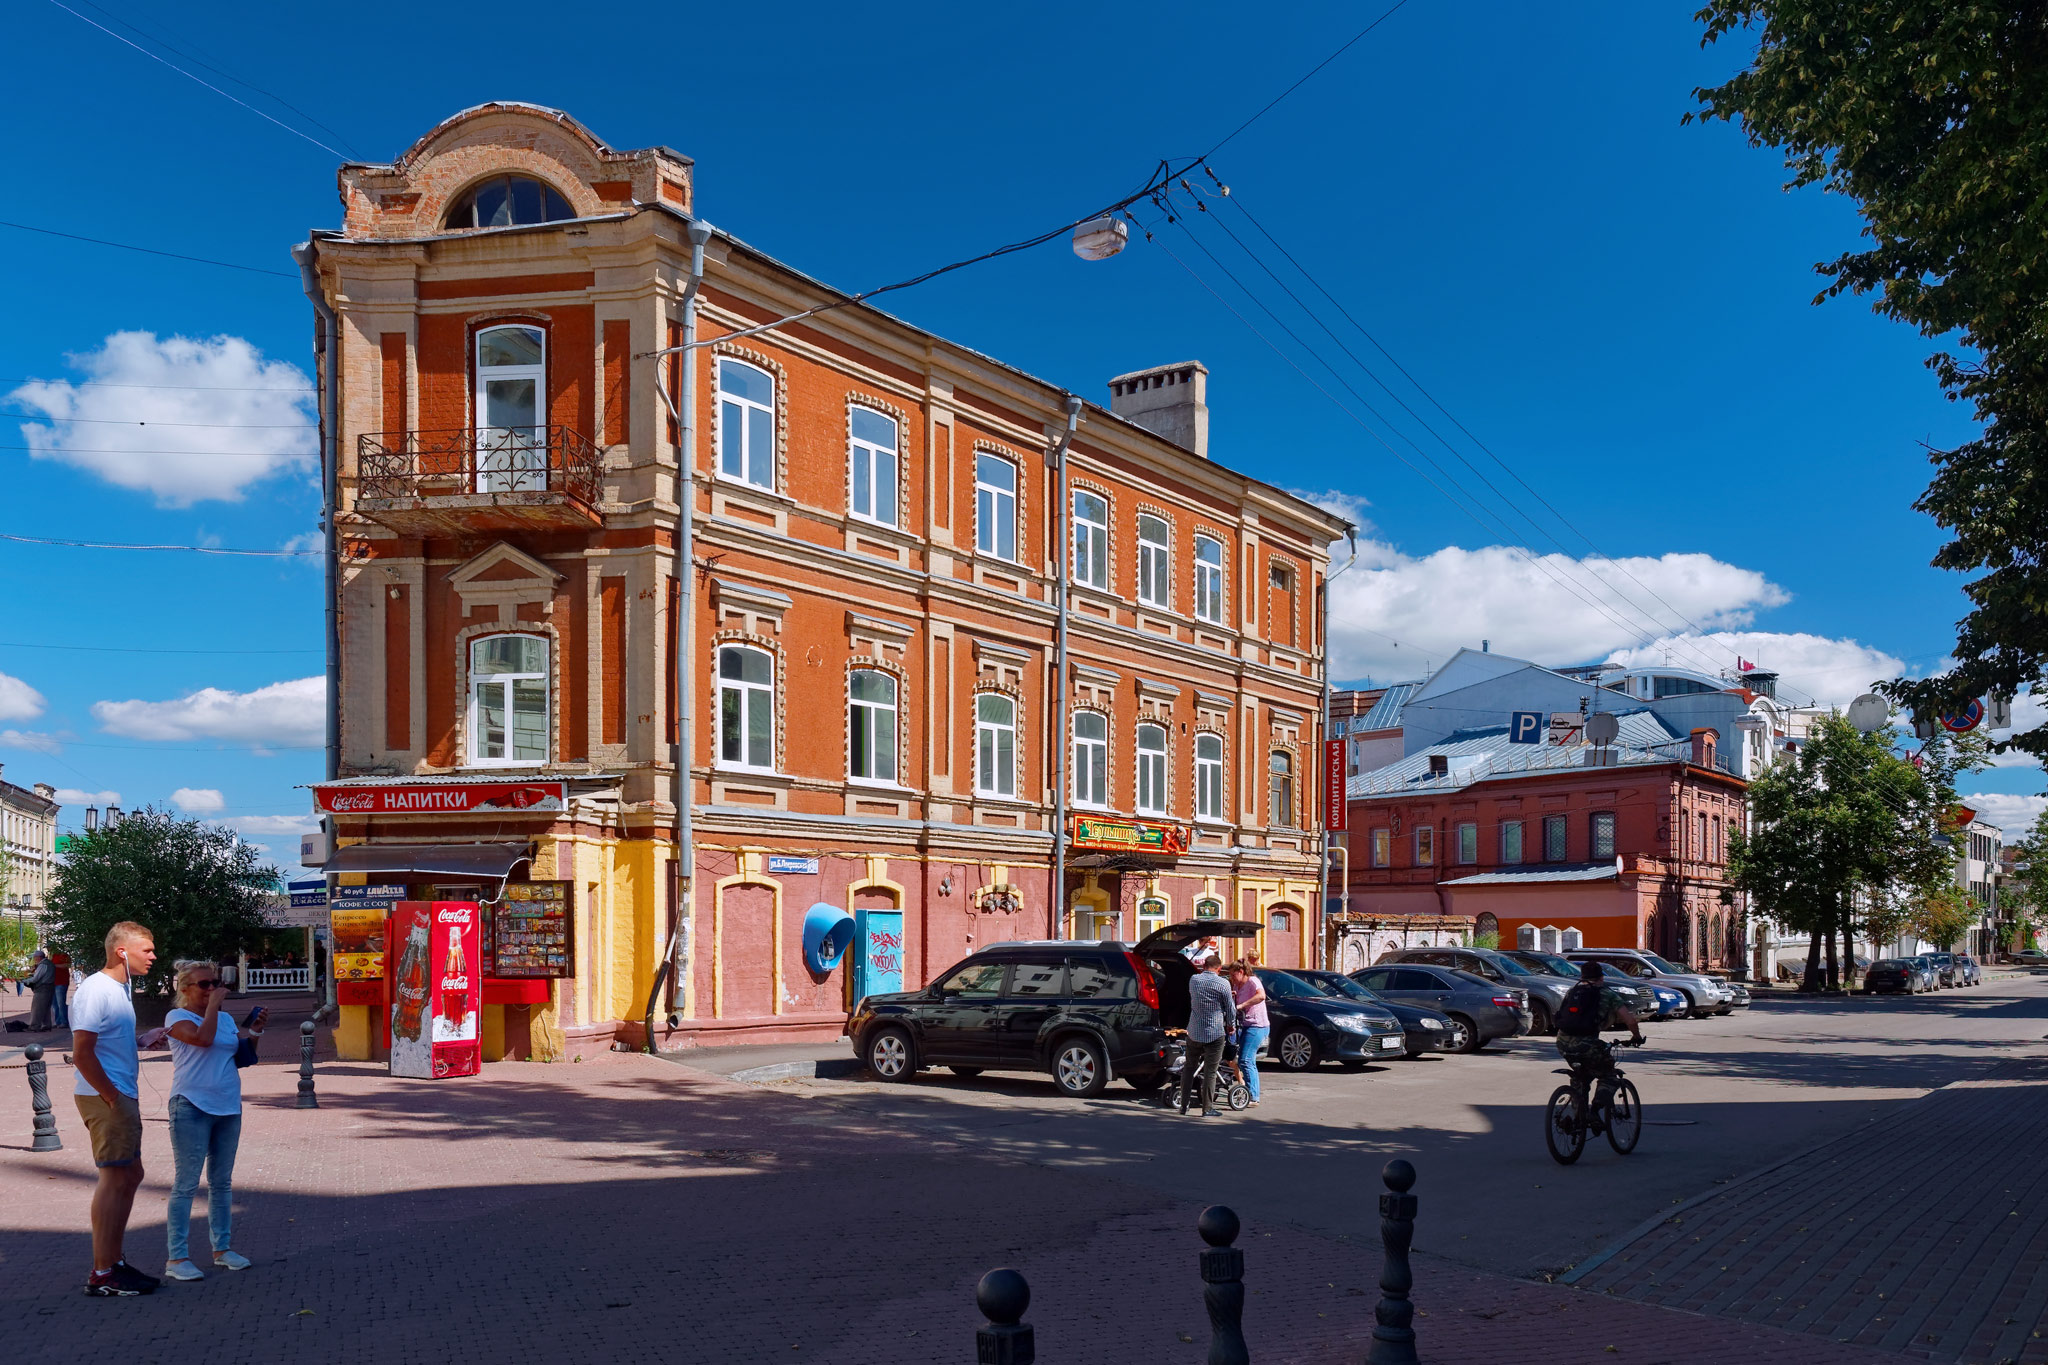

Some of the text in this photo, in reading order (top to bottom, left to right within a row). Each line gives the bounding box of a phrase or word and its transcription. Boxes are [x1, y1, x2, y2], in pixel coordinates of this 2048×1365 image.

[1518, 714, 1537, 741] P
[1332, 742, 1340, 828] КОНДИТЕРСКАЯ
[384, 792, 468, 809] НАПИТКИ
[366, 884, 405, 895] LAVAZZA
[437, 908, 472, 923] Coca-Cola
